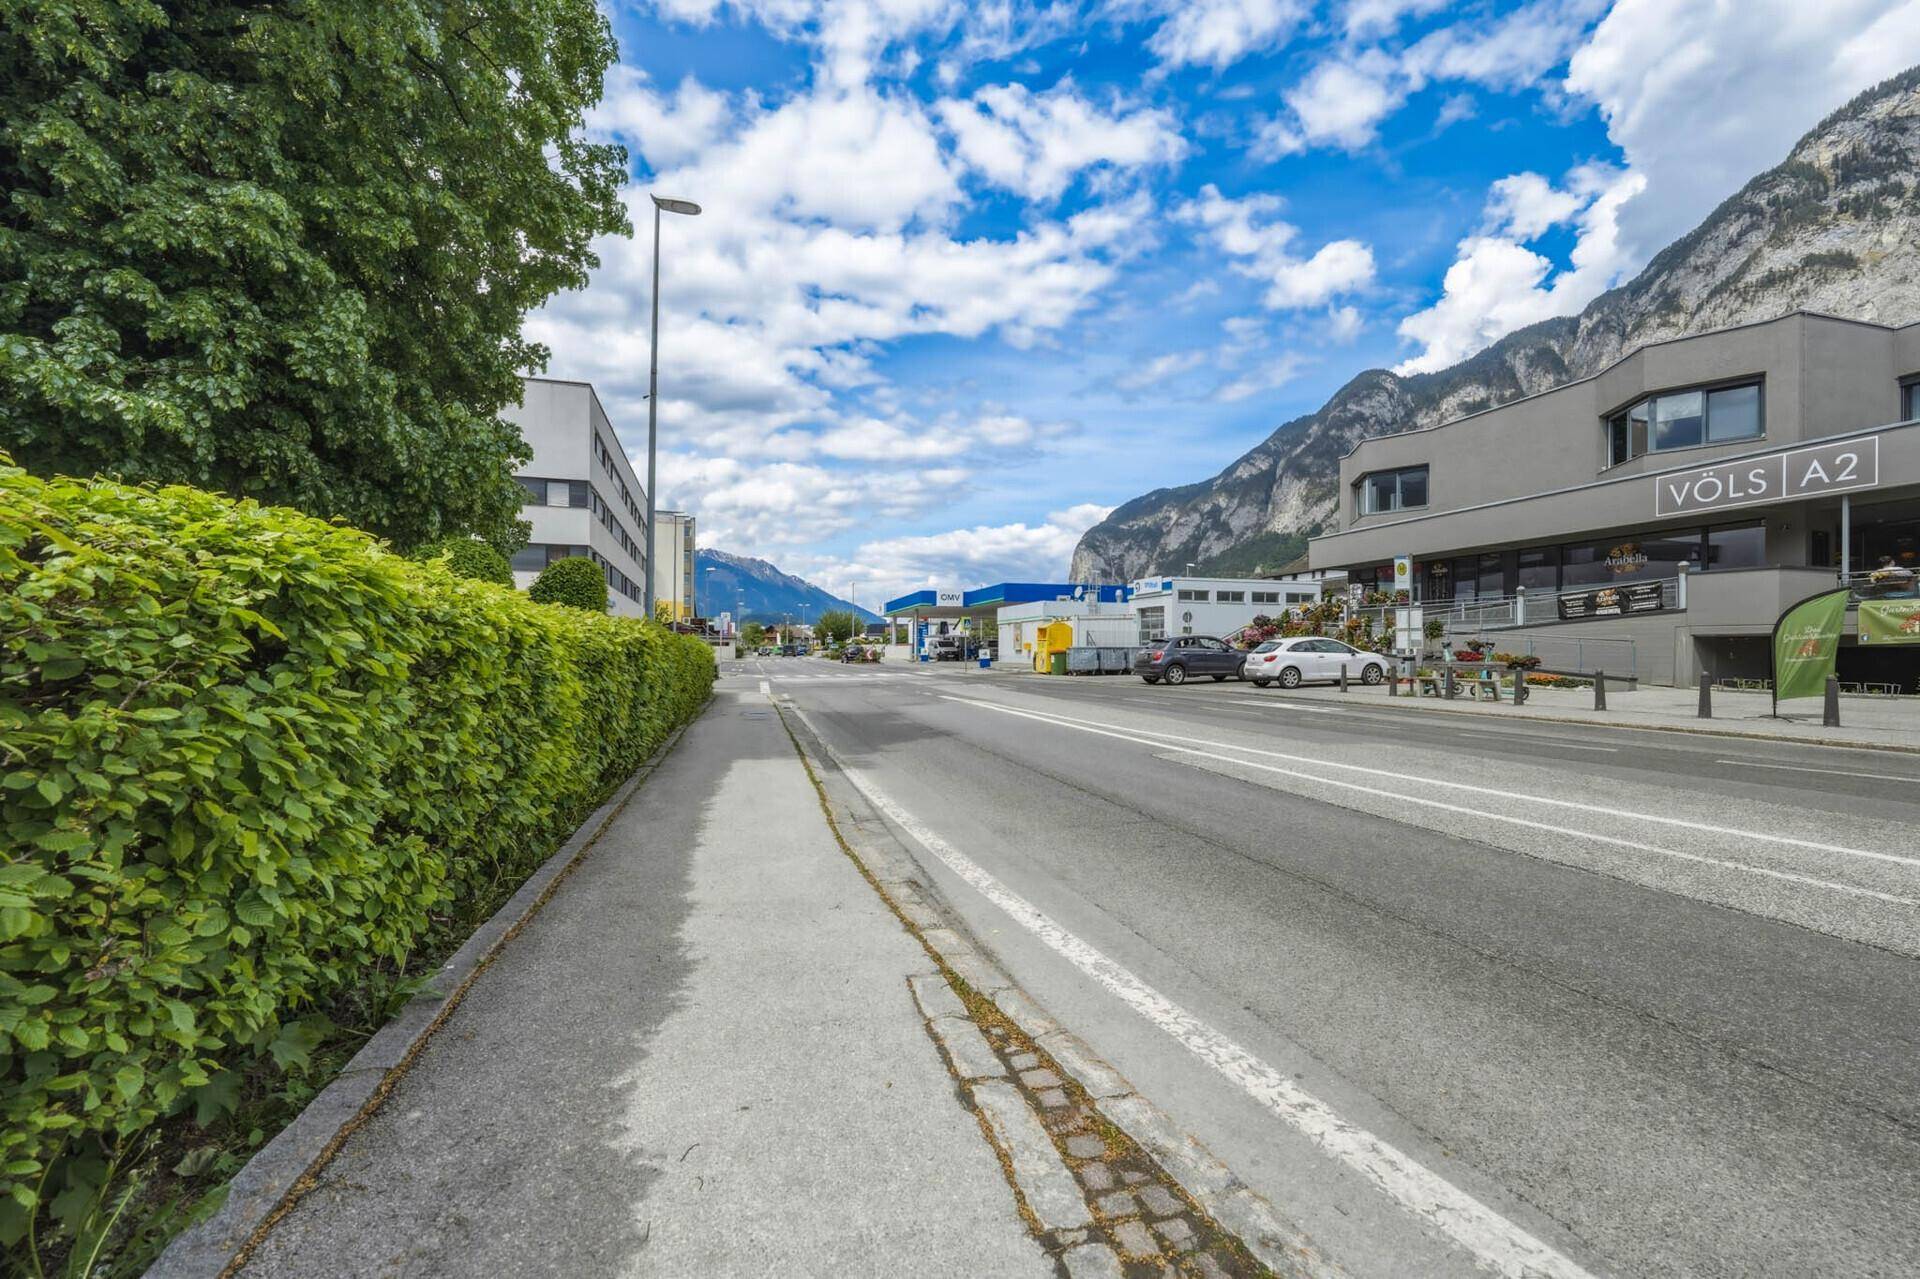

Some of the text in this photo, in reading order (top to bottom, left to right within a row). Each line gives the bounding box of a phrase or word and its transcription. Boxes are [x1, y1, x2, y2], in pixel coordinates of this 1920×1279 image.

[1669, 452, 1859, 507] VÖLS A2
[1604, 553, 1648, 566] Arabella
[940, 593, 961, 601] OMV
